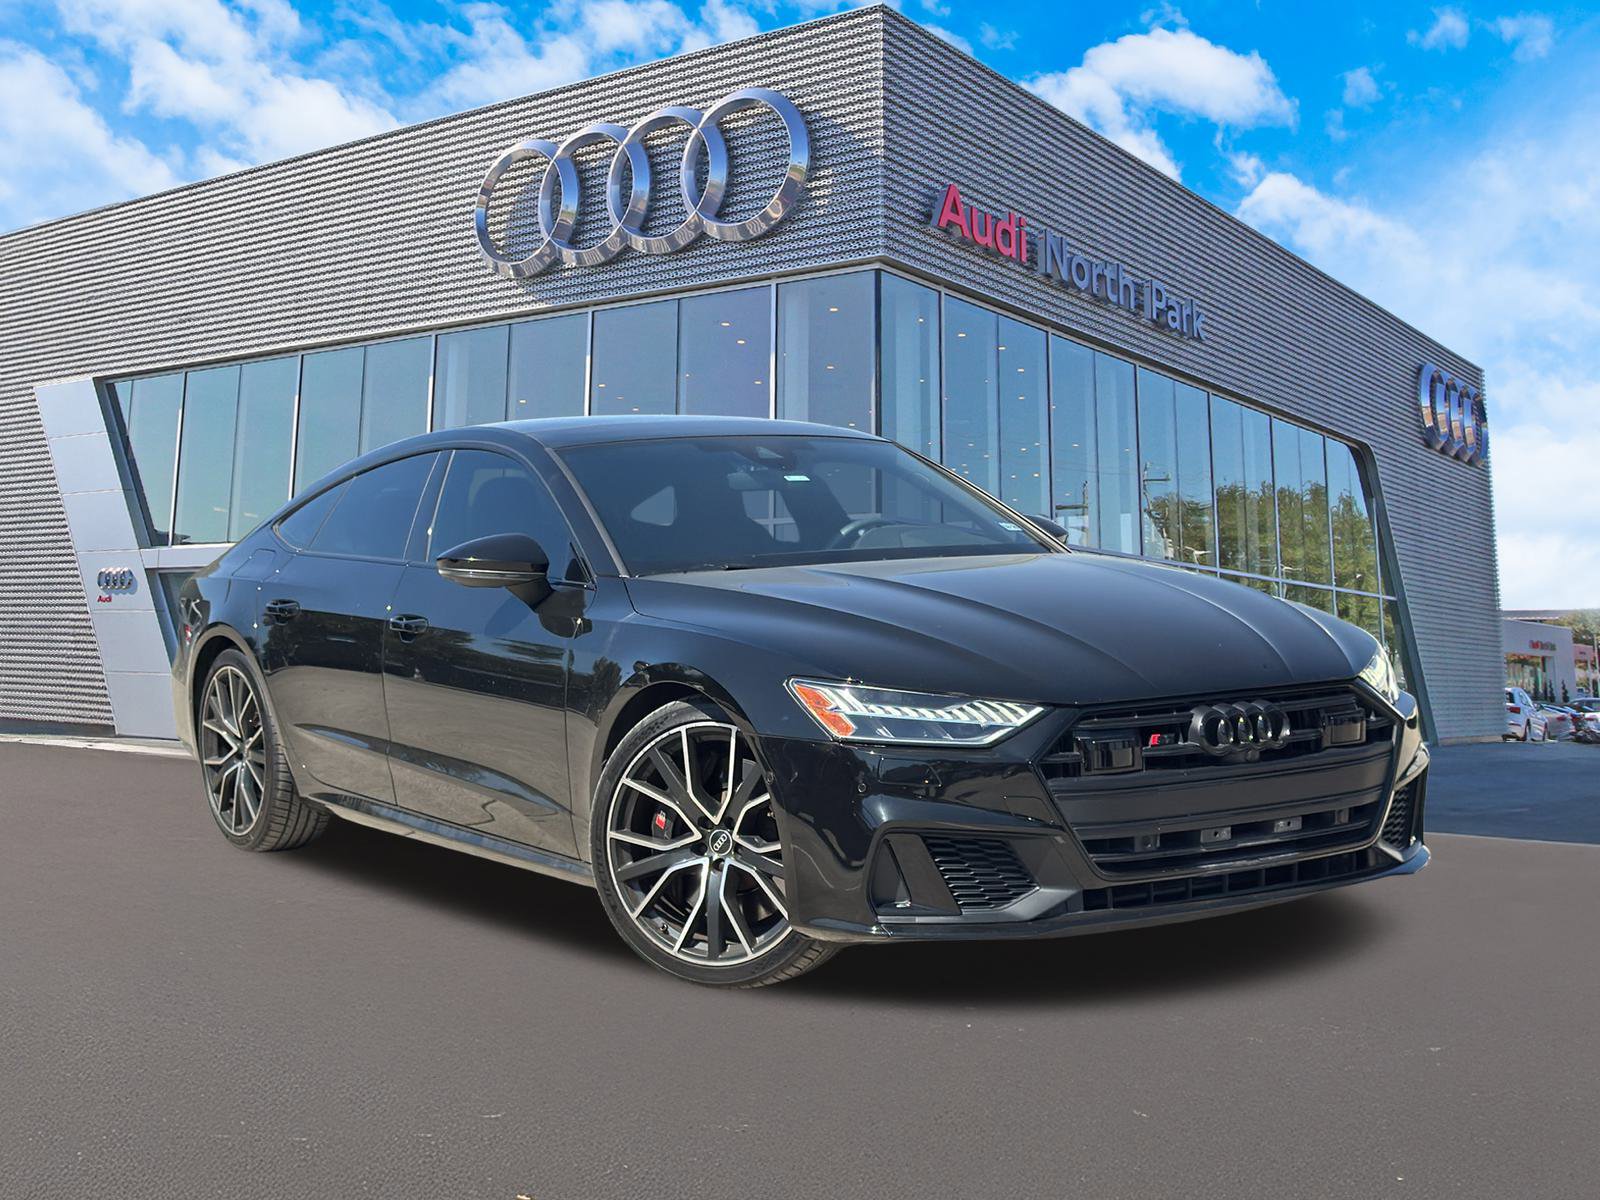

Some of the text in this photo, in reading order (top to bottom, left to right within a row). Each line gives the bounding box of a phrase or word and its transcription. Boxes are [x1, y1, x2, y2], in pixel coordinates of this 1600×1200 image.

[932, 183, 1207, 340] Audi North Park
